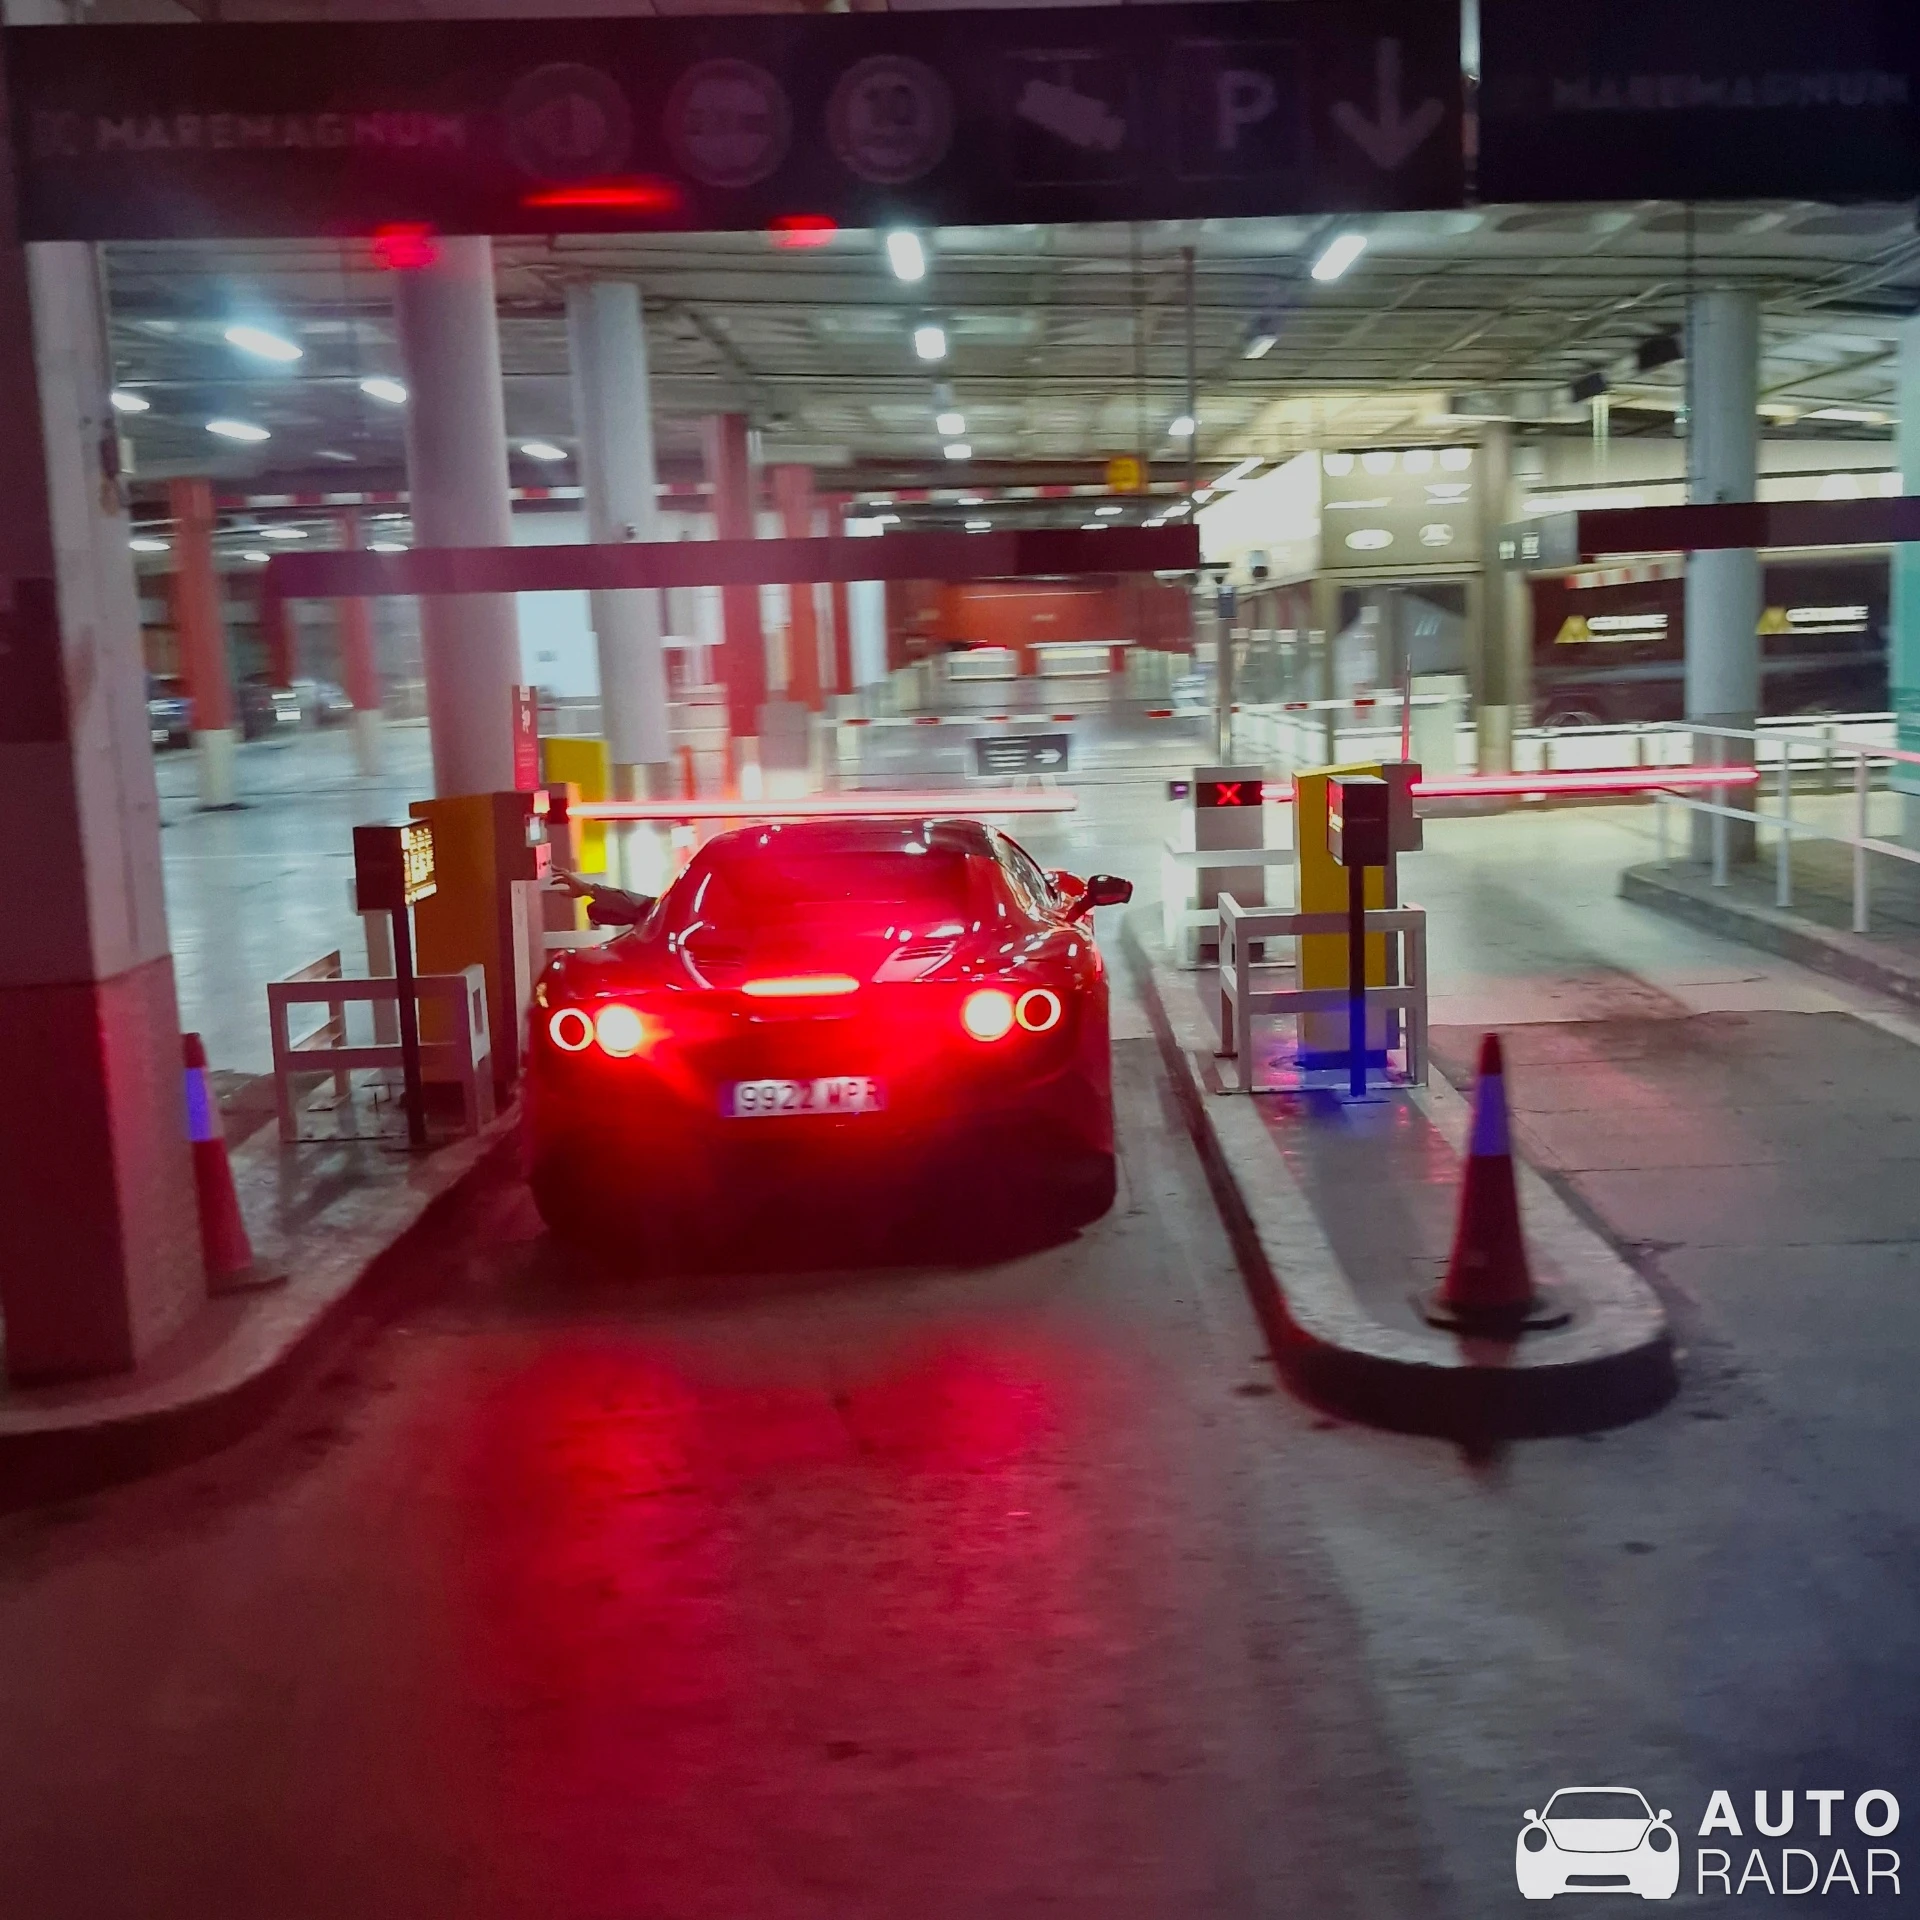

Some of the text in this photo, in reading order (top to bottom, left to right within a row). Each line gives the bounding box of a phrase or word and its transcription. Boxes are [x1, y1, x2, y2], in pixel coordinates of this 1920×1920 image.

[1217, 69, 1278, 149] P
[1551, 72, 1908, 109] MAREMAGNUM
[96, 111, 467, 150] MAREMAGNUM
